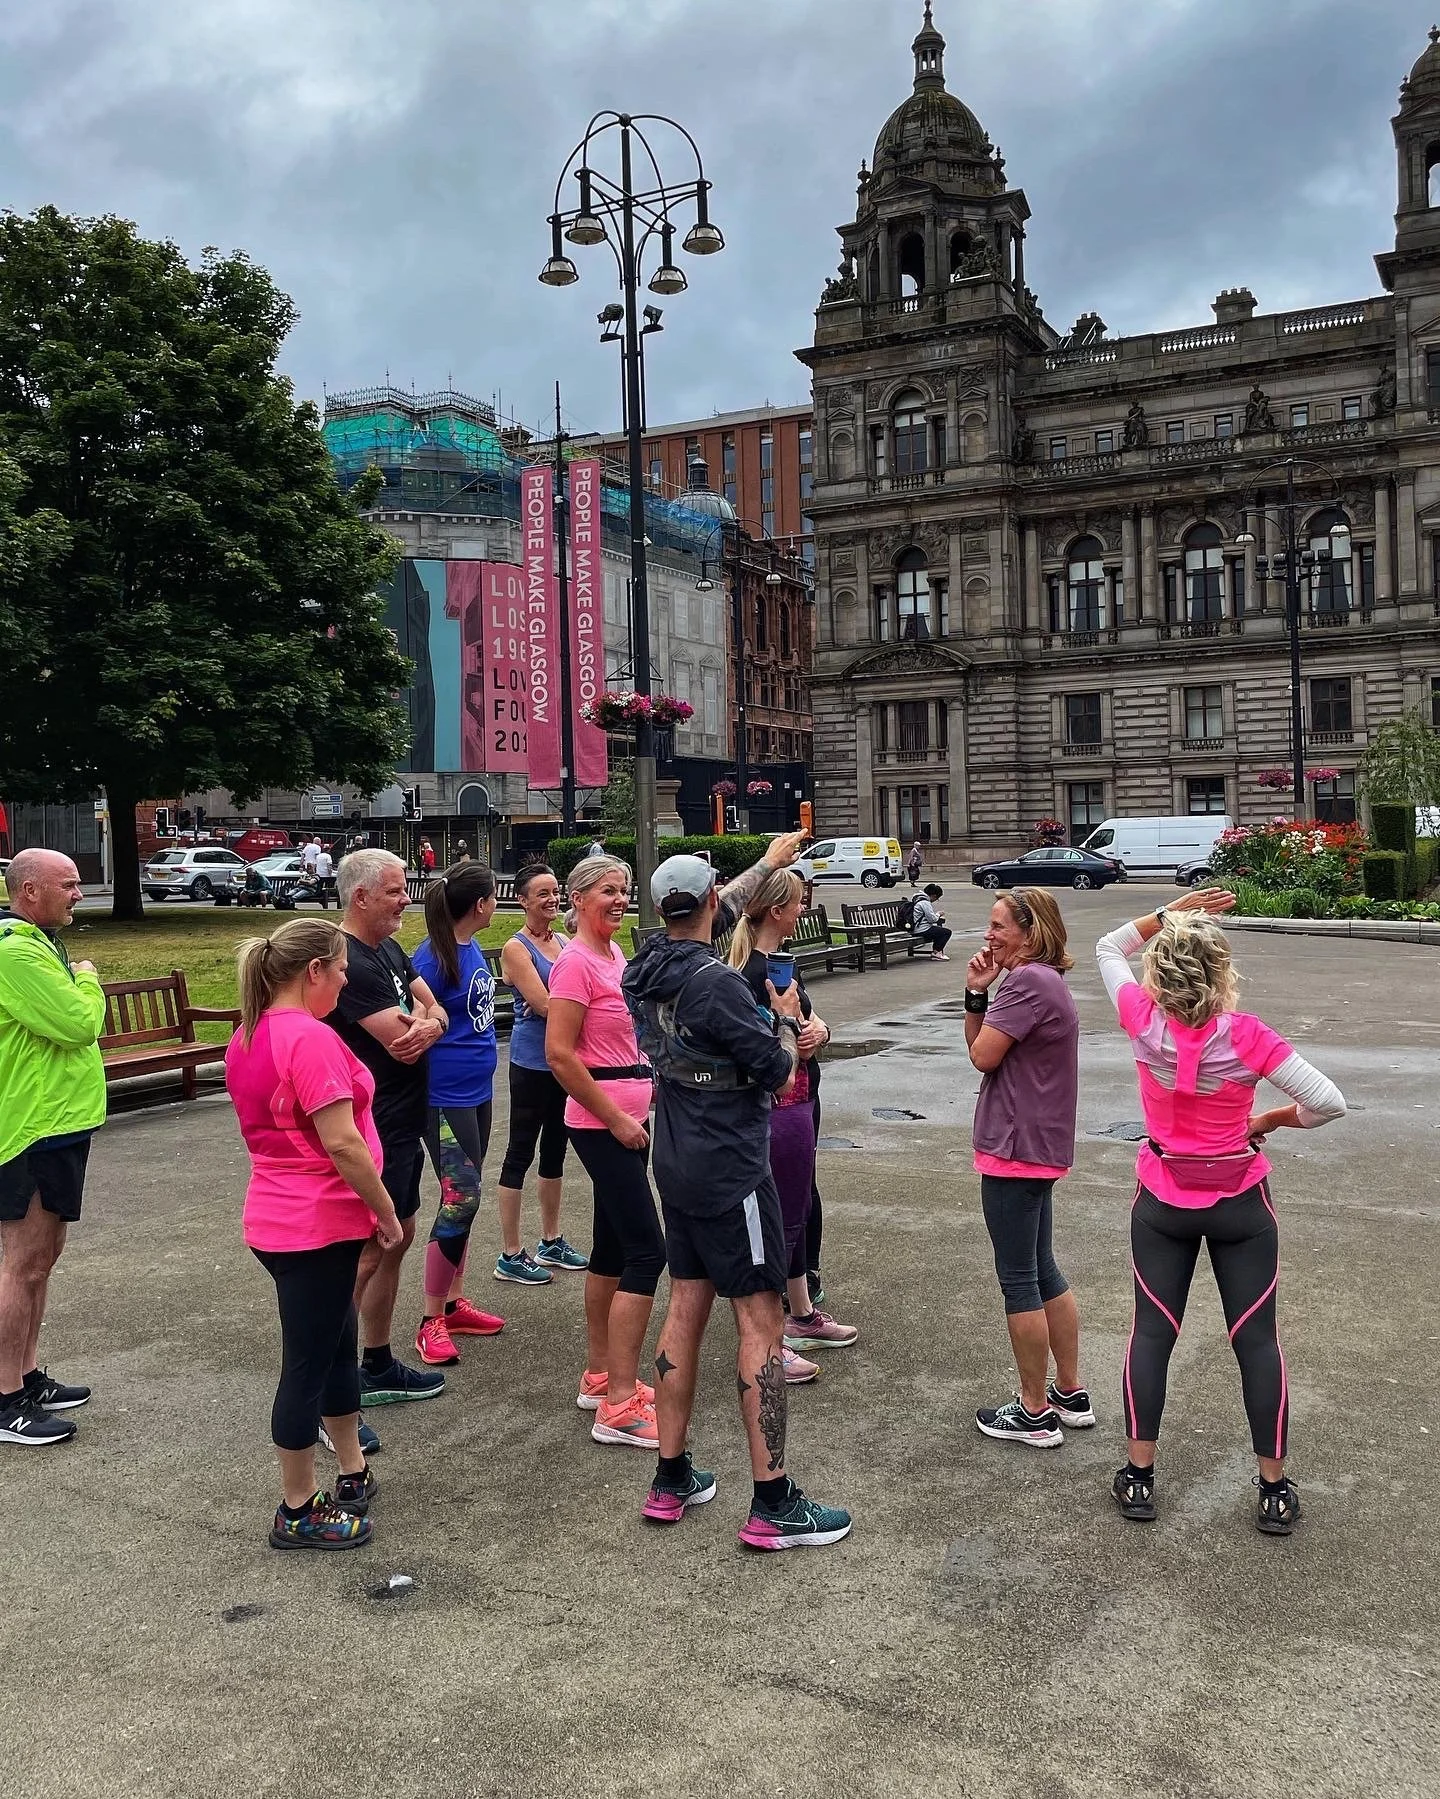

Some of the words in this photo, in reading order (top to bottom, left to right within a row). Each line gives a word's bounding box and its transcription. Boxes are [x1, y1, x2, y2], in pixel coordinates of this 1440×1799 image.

[528, 475, 545, 550] PEOPLE
[576, 467, 592, 543] PEOPLE
[491, 574, 525, 601] LOV
[528, 556, 546, 614] MAKE
[576, 550, 592, 609] MAKE
[492, 605, 526, 632] LOS
[492, 636, 526, 663] 196
[529, 617, 549, 723] GLASGOW
[577, 612, 596, 700] GLASGO
[493, 667, 527, 693] LOV
[494, 729, 528, 754] 201
